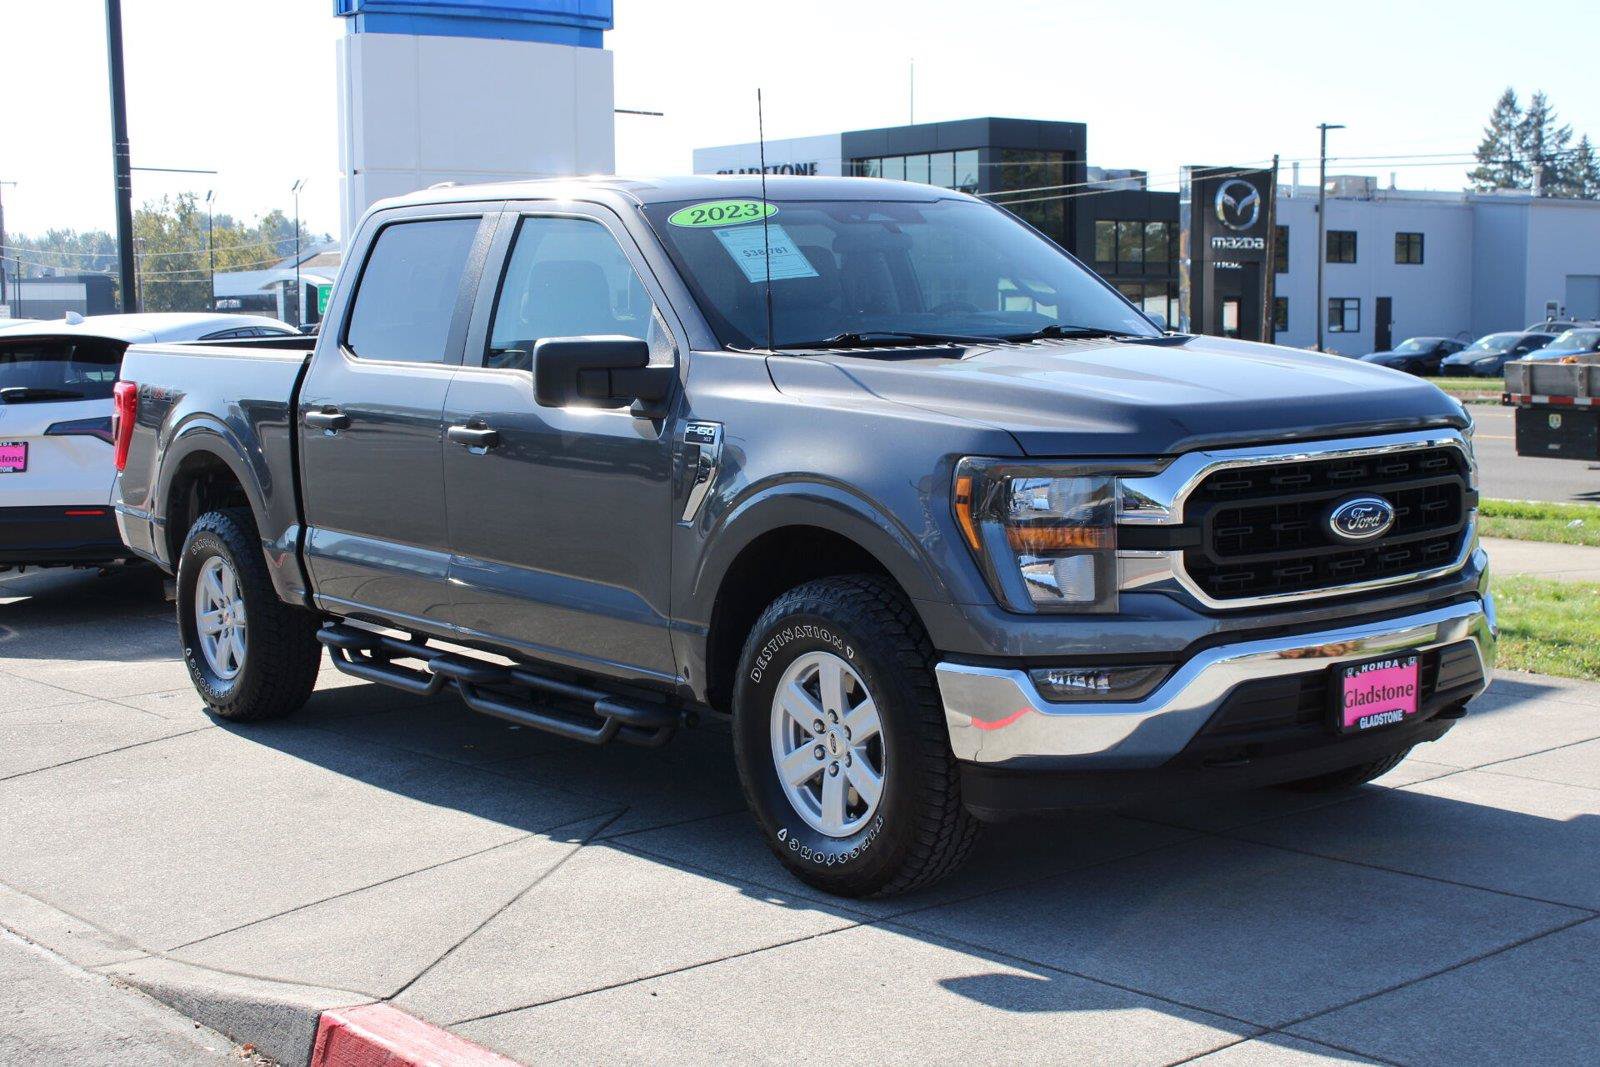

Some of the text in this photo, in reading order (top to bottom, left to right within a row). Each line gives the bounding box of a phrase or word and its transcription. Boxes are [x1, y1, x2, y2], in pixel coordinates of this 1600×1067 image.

[690, 203, 760, 225] 2023
[1347, 507, 1383, 530] Ford
[750, 625, 843, 683] DESTINATION
[1361, 659, 1399, 673] HONDA
[1344, 683, 1414, 709] Gladstone
[1360, 709, 1403, 730] GLADSTONE
